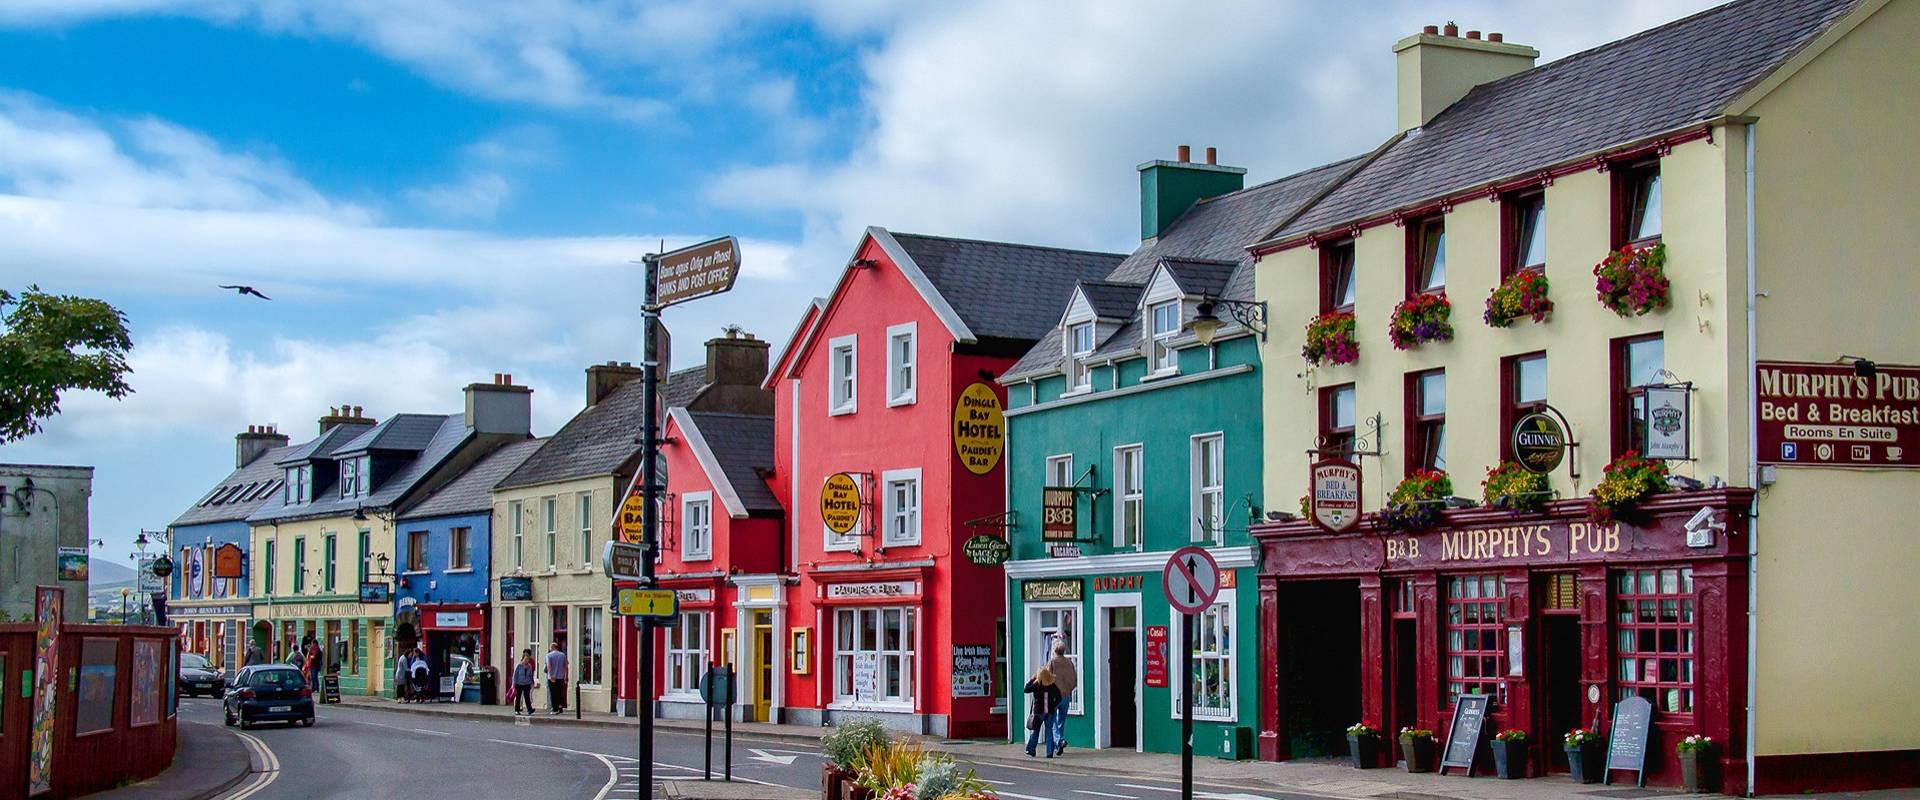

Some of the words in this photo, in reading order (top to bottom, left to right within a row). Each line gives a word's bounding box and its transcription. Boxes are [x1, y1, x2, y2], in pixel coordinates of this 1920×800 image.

[675, 261, 688, 277] agus
[704, 255, 712, 266] an
[659, 280, 677, 297] BANKS
[677, 276, 690, 291] AND
[690, 272, 707, 288] POST
[707, 266, 729, 285] OFFICE
[1759, 368, 1869, 400] MURPHY'S
[1875, 372, 1919, 401] PUB
[963, 395, 996, 408] DINGLE
[969, 409, 990, 420] BAY
[1761, 401, 1798, 421] Bed
[1807, 402, 1820, 422] &
[1829, 403, 1920, 424] Breakfast
[957, 420, 1001, 439] HOTEL
[1789, 427, 1833, 438] Rooms
[1839, 428, 1854, 438] En
[1860, 428, 1892, 439] Suite
[1854, 448, 1864, 457] TV
[969, 456, 989, 466] BAR
[1317, 468, 1356, 481] MURPHY'S
[1325, 480, 1340, 490] BED
[1341, 480, 1346, 490] &
[1316, 489, 1356, 500] BREAKFAST
[824, 499, 857, 510] HOTEL
[624, 513, 643, 524] BA
[1045, 507, 1073, 524] B&B
[833, 521, 848, 529] BAR
[1440, 524, 1552, 561] MURPHY'S
[1569, 522, 1621, 554] PUB
[1093, 575, 1143, 591] MURPHY
[283, 605, 304, 616] DINGLE
[306, 604, 335, 616] WOOLLEN
[337, 603, 366, 616] COMPANY
